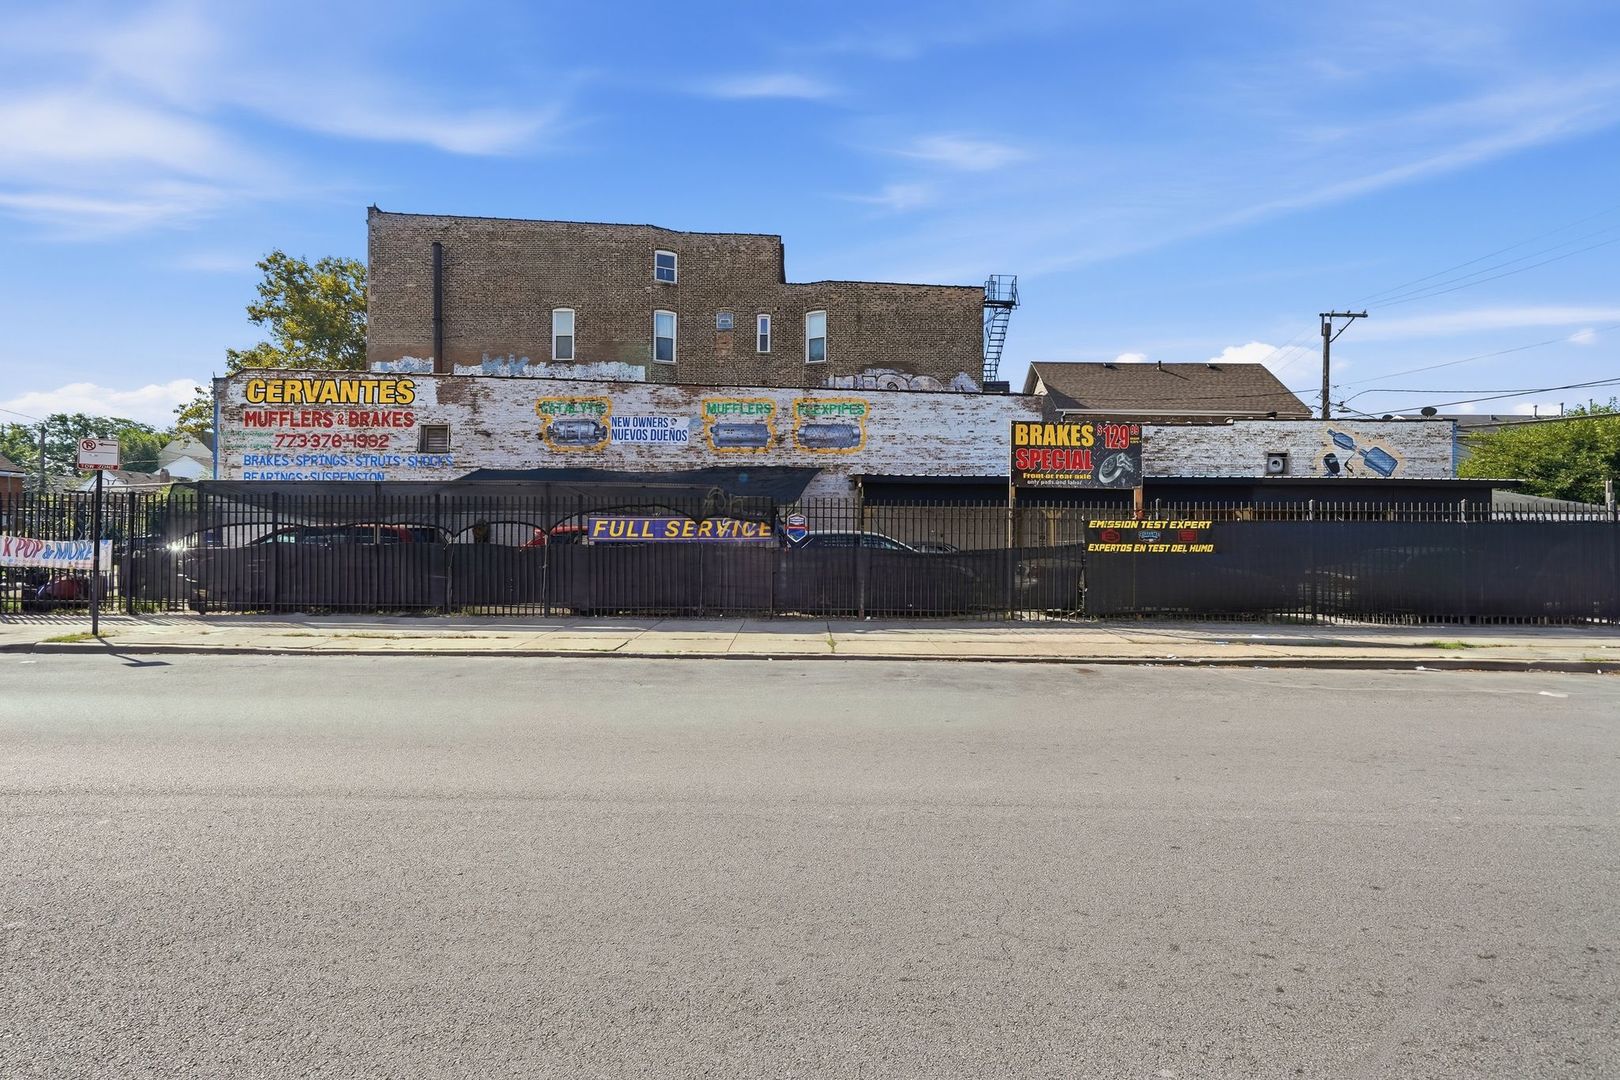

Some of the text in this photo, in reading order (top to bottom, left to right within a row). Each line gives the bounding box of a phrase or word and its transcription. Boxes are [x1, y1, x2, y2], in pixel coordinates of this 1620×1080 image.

[246, 378, 415, 404] CERVANTES
[706, 402, 771, 415] MUFFLERS
[244, 411, 415, 428] MUFFLERS & BRAKES
[611, 417, 669, 428] NEW OWNERS
[611, 428, 688, 441] NUEVOS DUEÑOS
[1015, 424, 1094, 447] BRAKES
[243, 454, 454, 468] BRAKES SPRINGS STRUTS SHOCKS
[1016, 448, 1094, 471] SPECIAL
[243, 472, 303, 480] BEARINGS
[593, 520, 654, 537] FULL
[665, 520, 772, 537] SERVICE
[1089, 520, 1212, 529] EMISSION TEST EXPERT
[3, 537, 13, 557] K
[15, 538, 43, 558] POP
[54, 540, 92, 560] MORE
[1088, 543, 1214, 552] EXPERTOS EN TEST DEL HUMO
